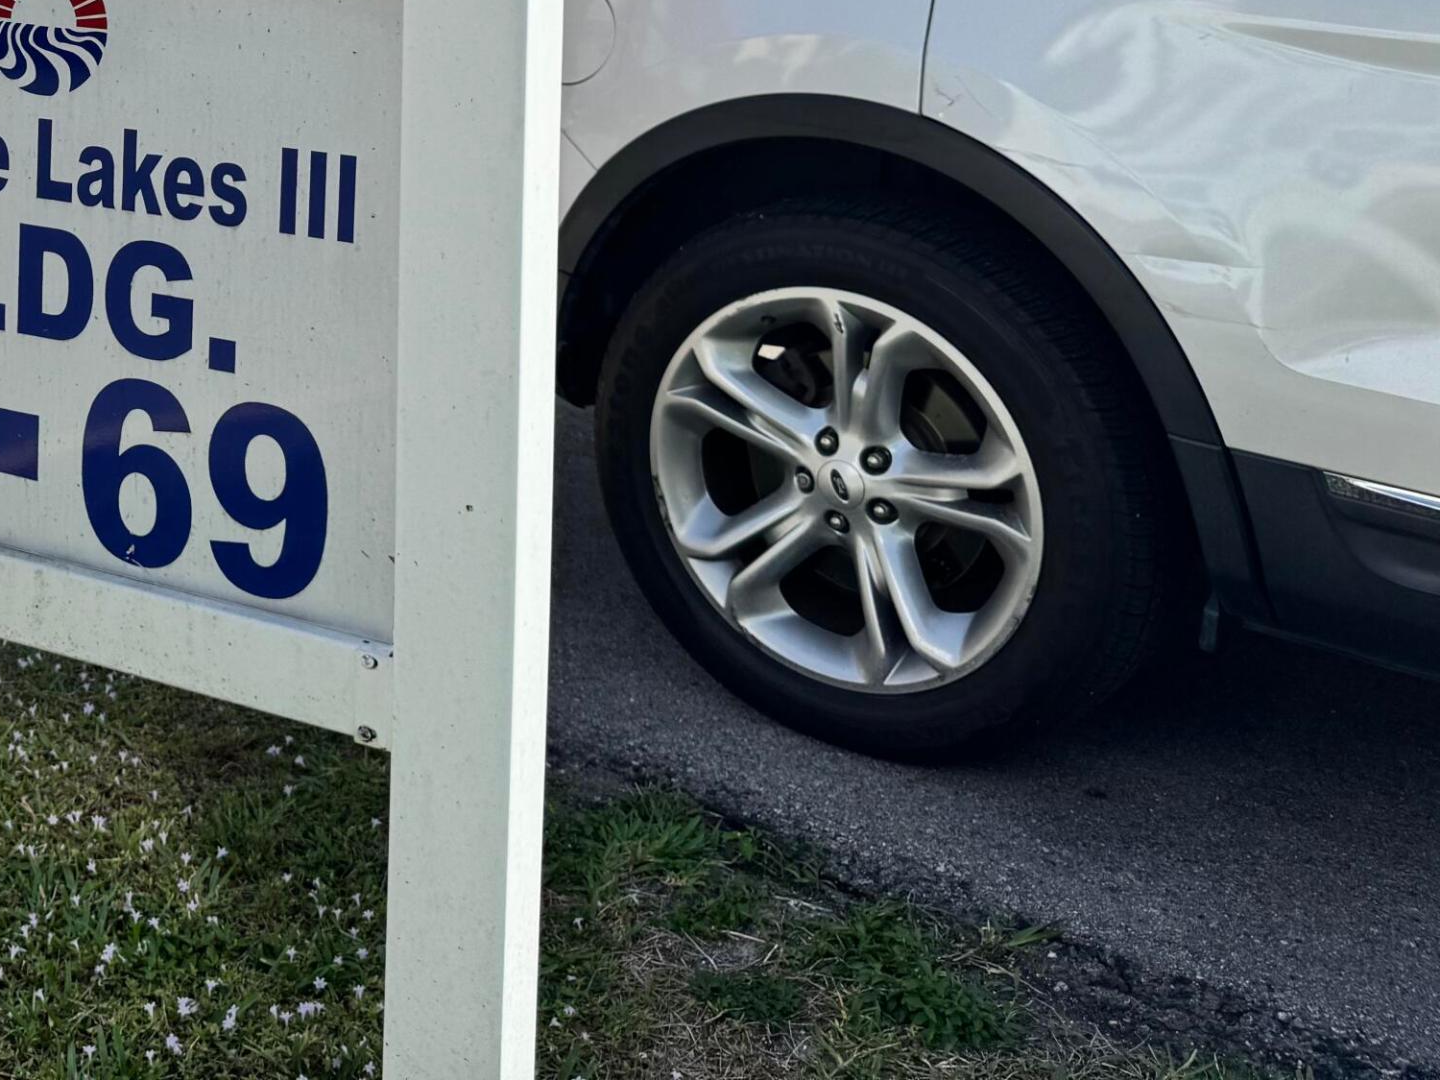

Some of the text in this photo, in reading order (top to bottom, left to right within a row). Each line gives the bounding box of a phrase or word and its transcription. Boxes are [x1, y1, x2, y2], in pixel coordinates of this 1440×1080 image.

[35, 118, 248, 227] Lakes
[279, 147, 357, 243] III
[81, 378, 328, 600] 69
